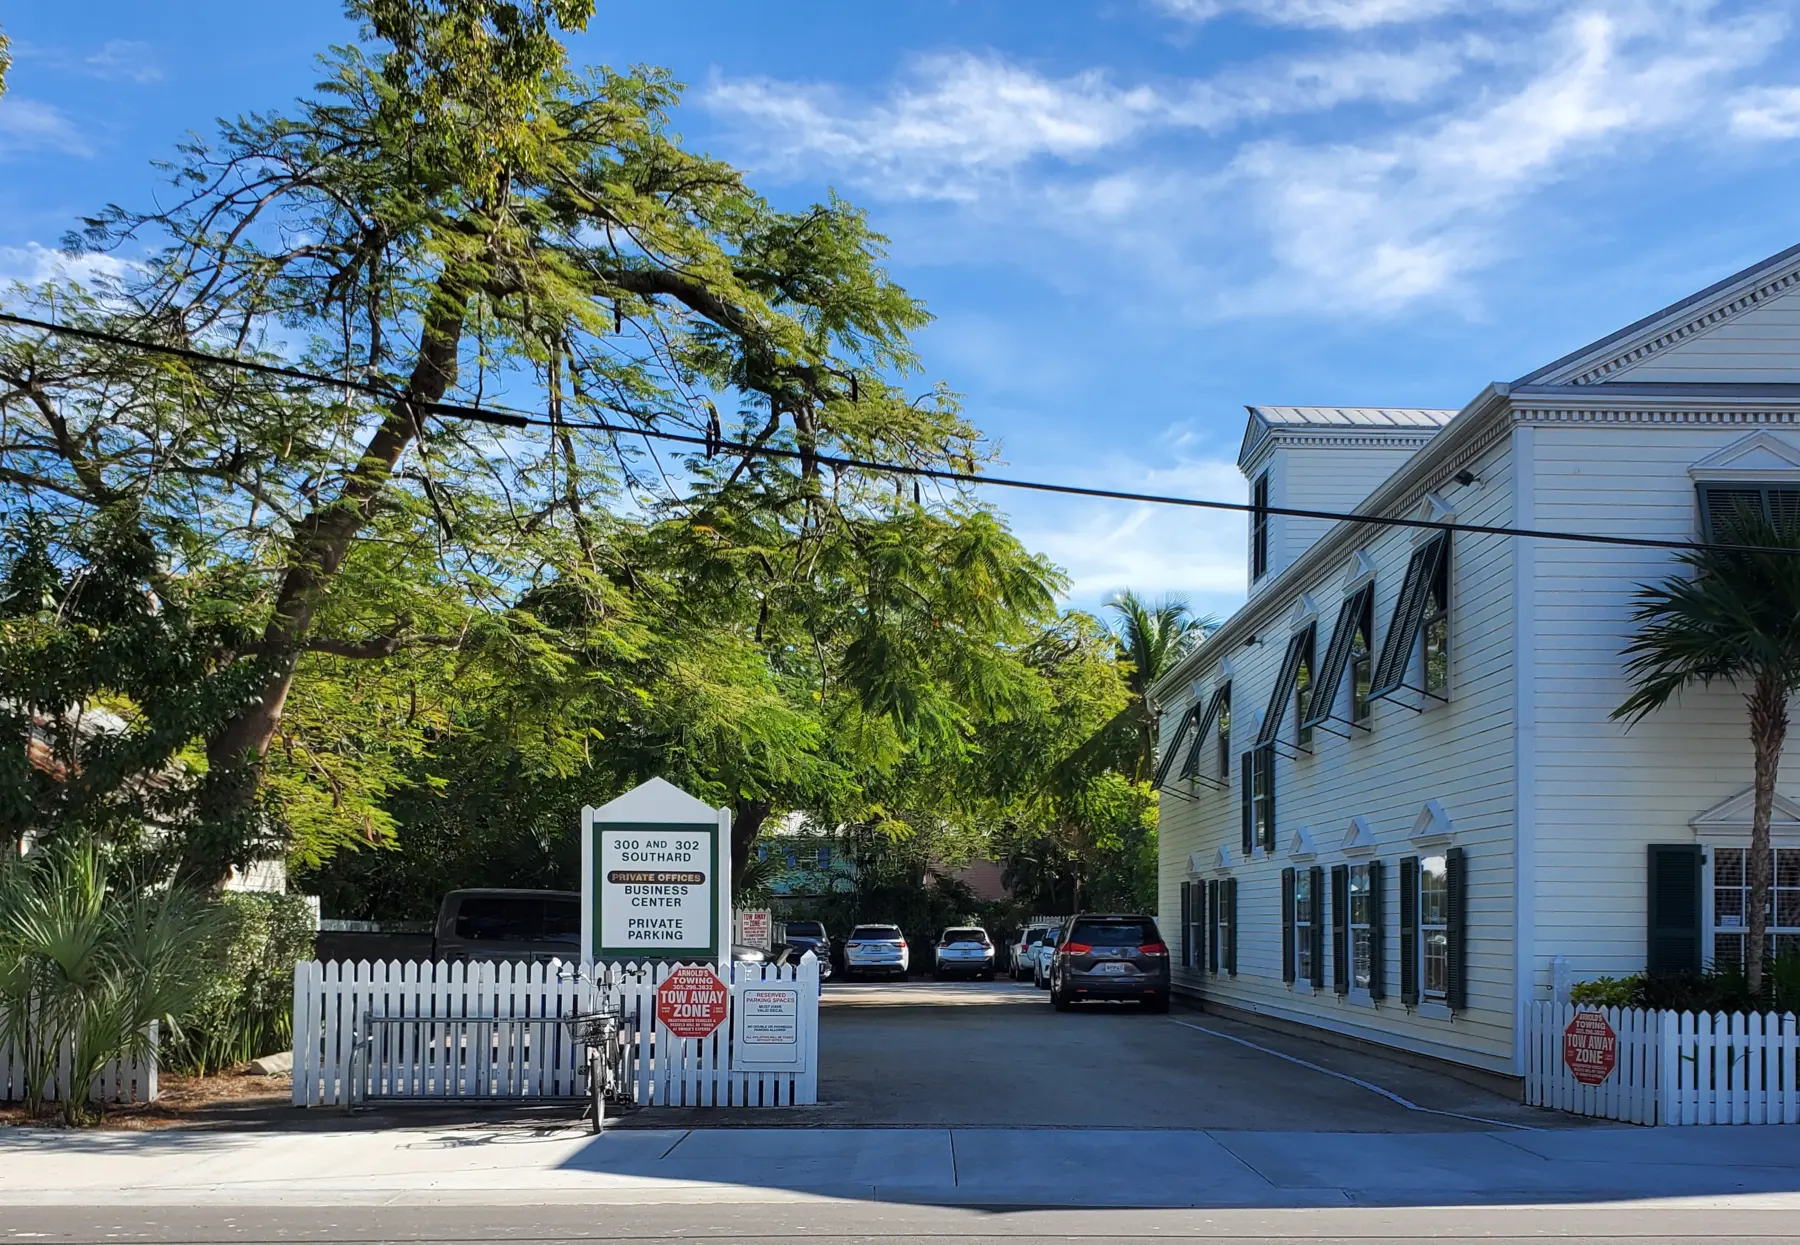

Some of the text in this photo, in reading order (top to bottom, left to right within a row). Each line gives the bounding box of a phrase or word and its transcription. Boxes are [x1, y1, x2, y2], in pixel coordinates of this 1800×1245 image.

[614, 840, 700, 850] 300 AND 302
[621, 852, 692, 862] SOUTHARD
[612, 873, 701, 882] PRIVATE OFFICES
[624, 886, 688, 895] BUSINESS
[631, 898, 682, 907] CENTER
[628, 918, 683, 928] PRIVATE
[628, 930, 683, 940] PARKING
[661, 990, 724, 1004] TOW AWAY
[673, 1004, 710, 1017] ZONE
[1576, 1021, 1606, 1029] TOWING
[1567, 1033, 1614, 1050] TOW AWAY
[1575, 1048, 1603, 1064] ZONE
